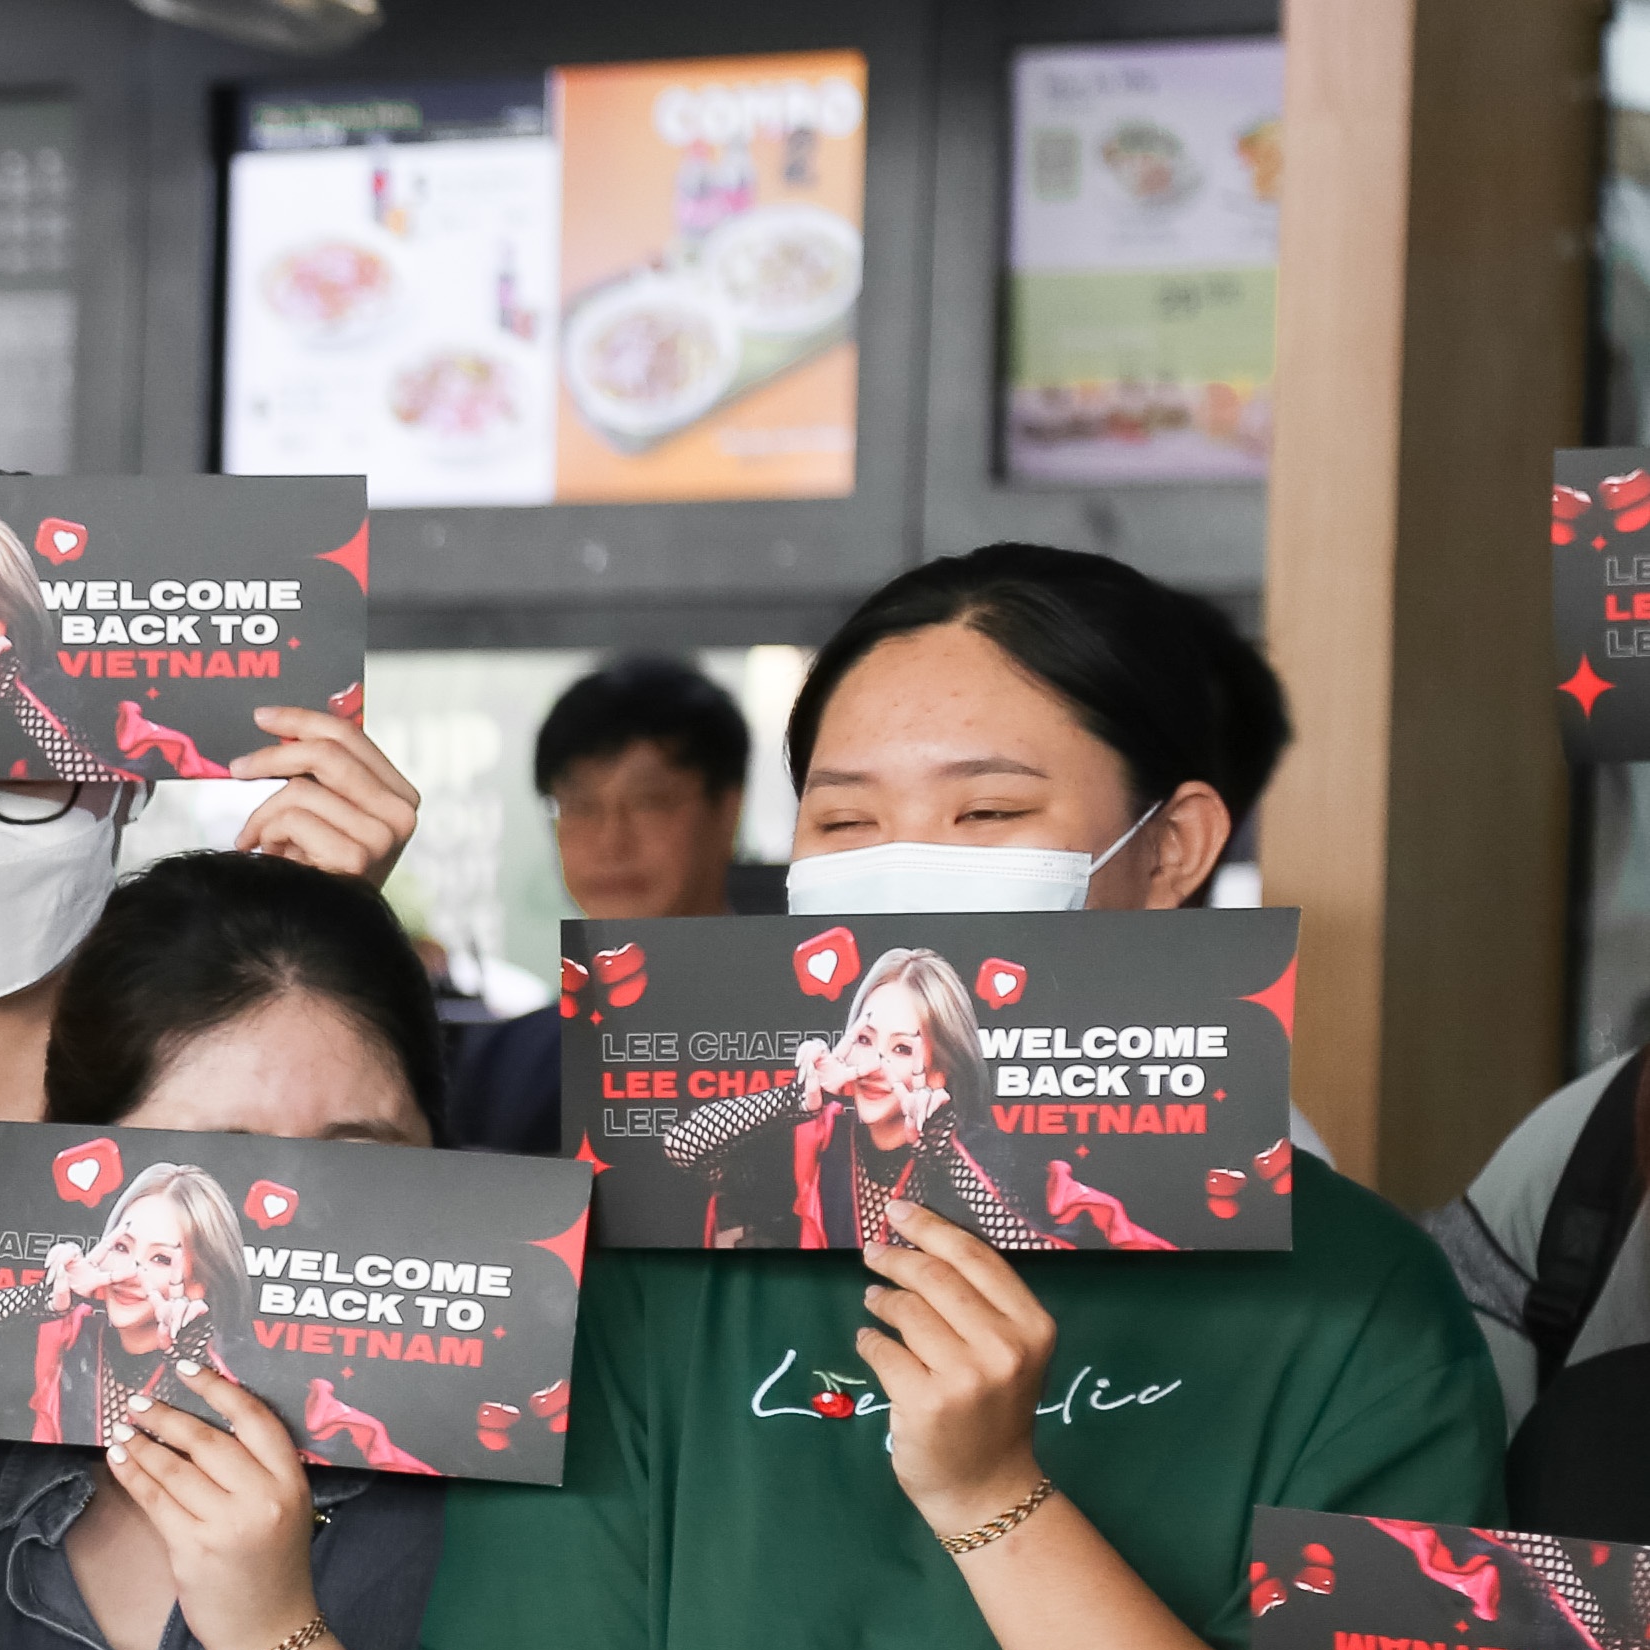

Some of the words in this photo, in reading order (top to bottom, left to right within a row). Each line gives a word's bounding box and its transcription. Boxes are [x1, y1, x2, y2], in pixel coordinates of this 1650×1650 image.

[1606, 556, 1650, 586] LE
[39, 580, 301, 610] WELCOME
[1605, 593, 1650, 621] LE
[61, 615, 201, 644] BACK
[210, 615, 278, 644] TO
[1606, 627, 1650, 658] LE
[57, 650, 280, 678] VIETNAM
[601, 1033, 678, 1062] LEE
[978, 1023, 1227, 1060] WELCOME
[600, 1070, 677, 1097] LEE
[997, 1064, 1129, 1097] BACK
[1139, 1063, 1205, 1096] TO
[993, 1103, 1206, 1135] VIETNAM
[244, 1245, 512, 1295] WELCOME
[259, 1283, 404, 1324] BACK
[414, 1294, 485, 1330] TO
[254, 1320, 484, 1367] VIETNAM
